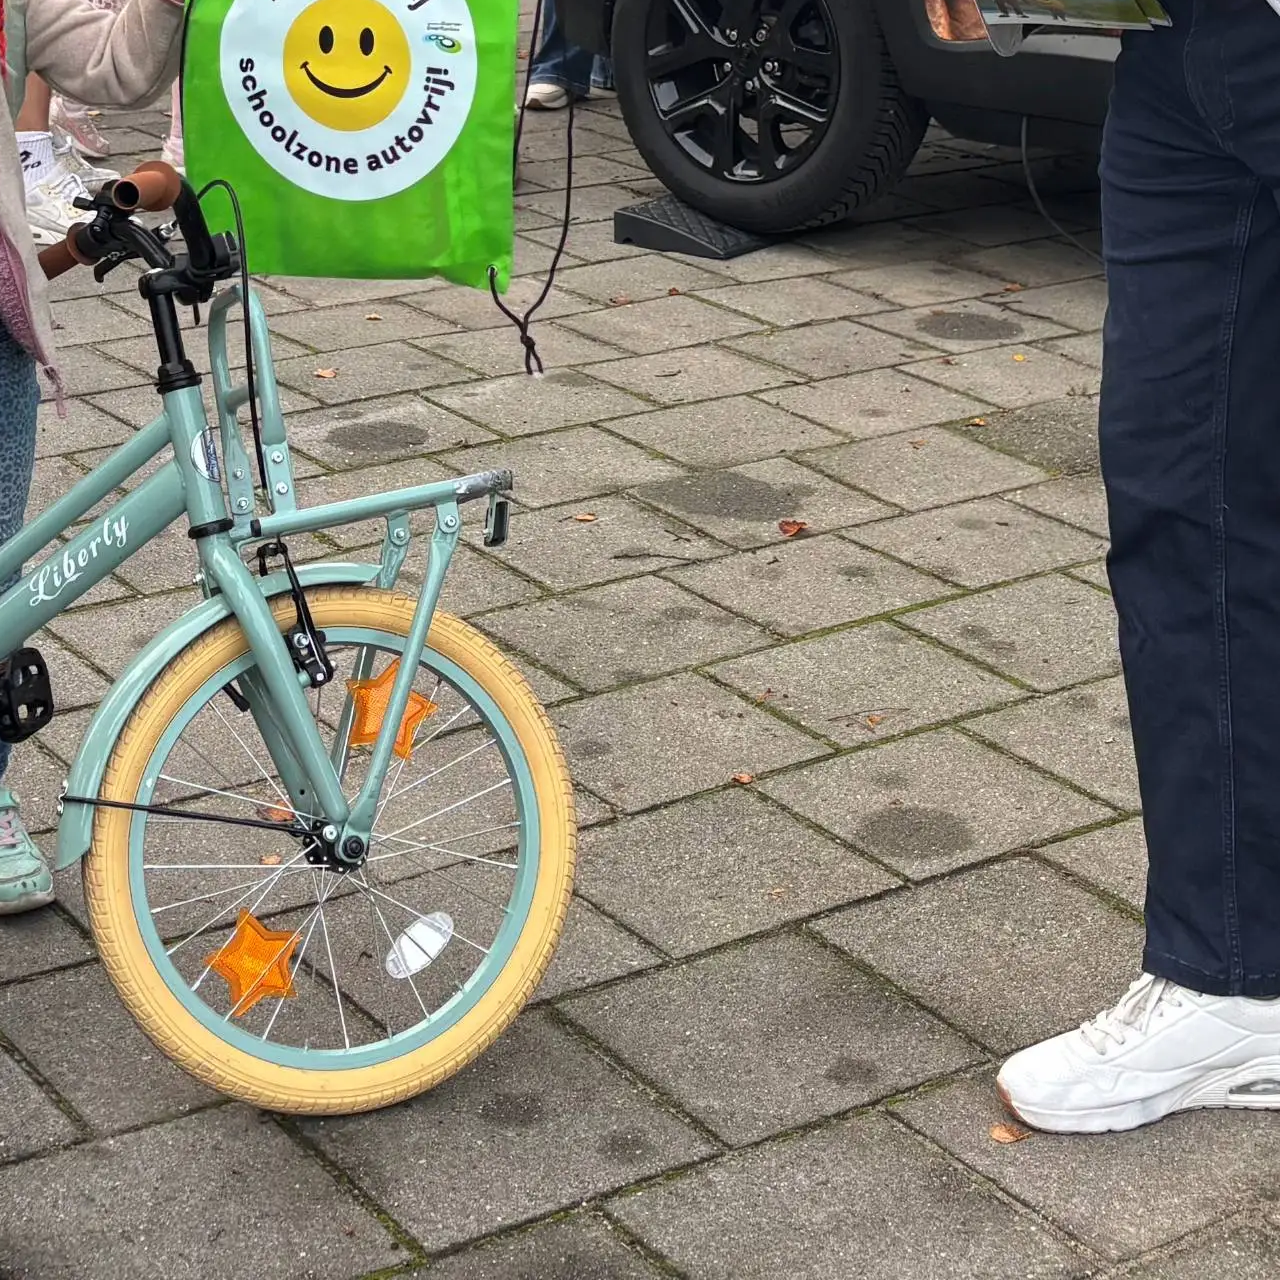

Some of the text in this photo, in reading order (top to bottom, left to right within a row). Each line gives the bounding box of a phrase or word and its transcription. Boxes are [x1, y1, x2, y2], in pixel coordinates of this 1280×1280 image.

[238, 57, 456, 175] schoolzone autovrij!
[28, 515, 130, 607] Liberty
